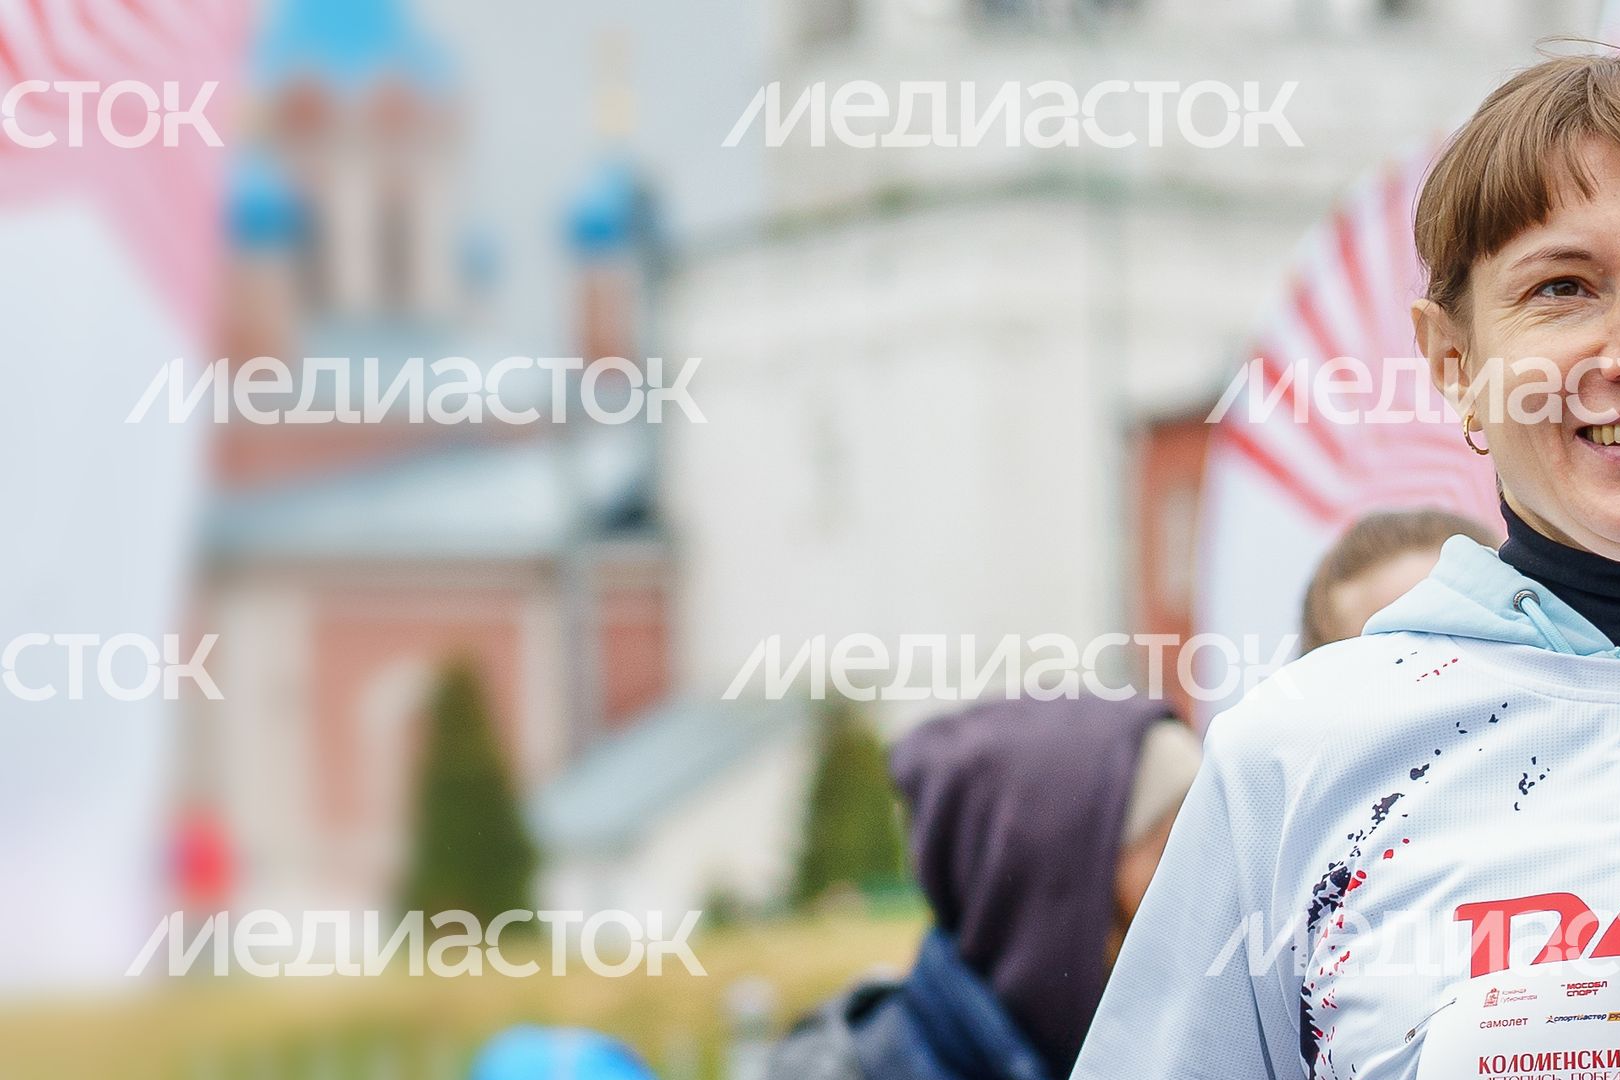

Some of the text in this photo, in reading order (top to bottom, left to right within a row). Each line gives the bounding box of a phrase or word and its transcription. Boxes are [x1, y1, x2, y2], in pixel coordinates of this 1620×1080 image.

[1566, 981, 1608, 991] МОСОБЛ
[1566, 988, 1599, 997] СПОРТ
[1479, 1017, 1529, 1030] самолет
